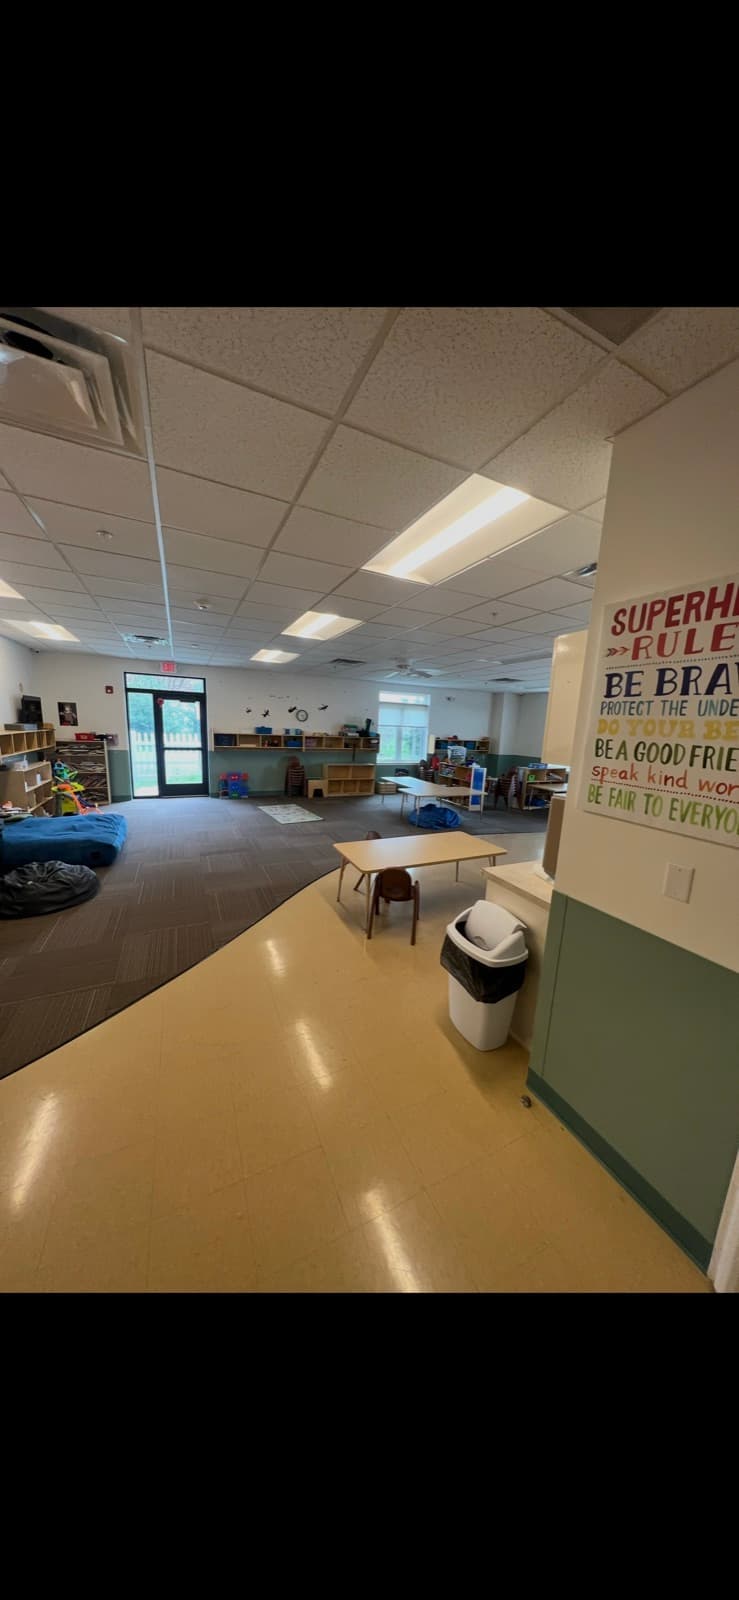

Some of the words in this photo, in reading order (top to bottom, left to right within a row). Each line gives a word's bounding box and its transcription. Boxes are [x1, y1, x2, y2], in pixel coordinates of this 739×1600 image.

[604, 671, 644, 698] BE
[600, 700, 654, 716] PROTECT
[661, 700, 688, 716] THE
[597, 719, 620, 736] DO
[626, 719, 696, 739] YOUR
[595, 738, 613, 759] BE
[615, 740, 628, 761] A
[633, 741, 686, 766] GOOD
[592, 763, 638, 784] speak
[648, 765, 688, 789] kind
[587, 784, 603, 804] BE
[608, 788, 637, 811] FAIR
[644, 793, 663, 817] TO
[669, 798, 739, 836] EVERYO
